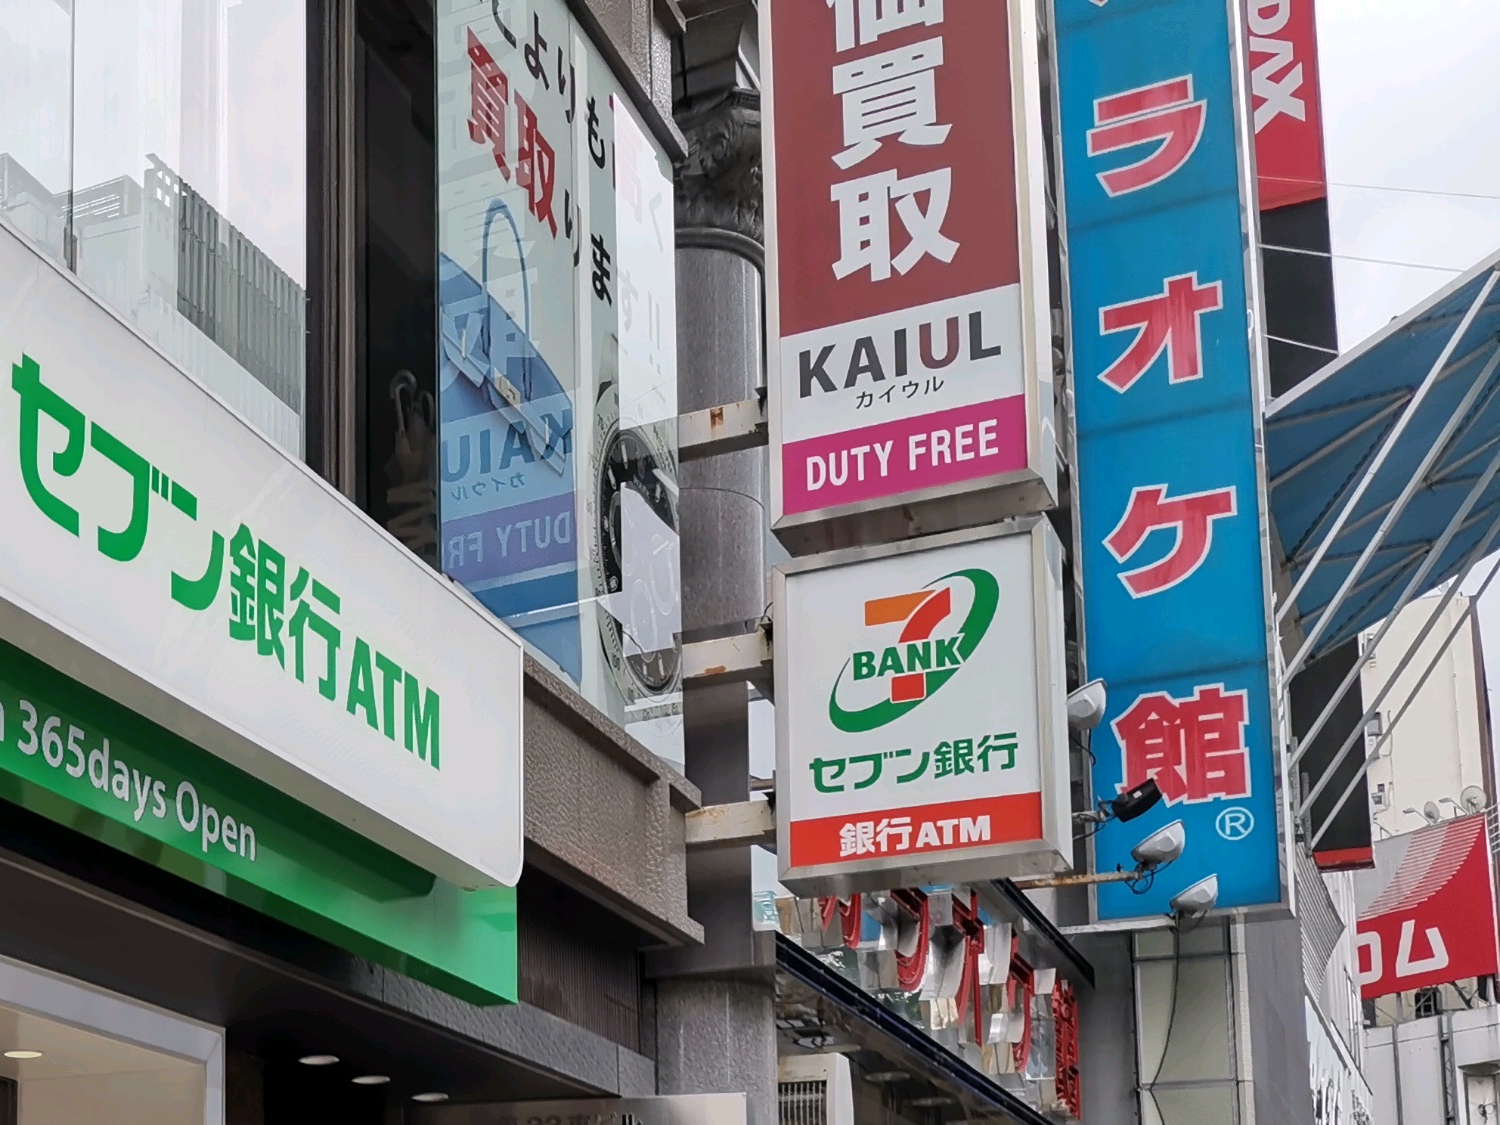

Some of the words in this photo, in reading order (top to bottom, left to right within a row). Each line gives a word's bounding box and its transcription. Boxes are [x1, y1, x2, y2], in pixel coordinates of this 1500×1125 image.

[800, 311, 1002, 398] KAIUL
[857, 375, 944, 409] カイウル
[806, 440, 894, 491] DUTY
[909, 418, 999, 471] FREE
[853, 637, 963, 681] BANK
[16, 698, 167, 822] 365days
[174, 781, 258, 862] Open
[809, 732, 1018, 793] セブン銀行
